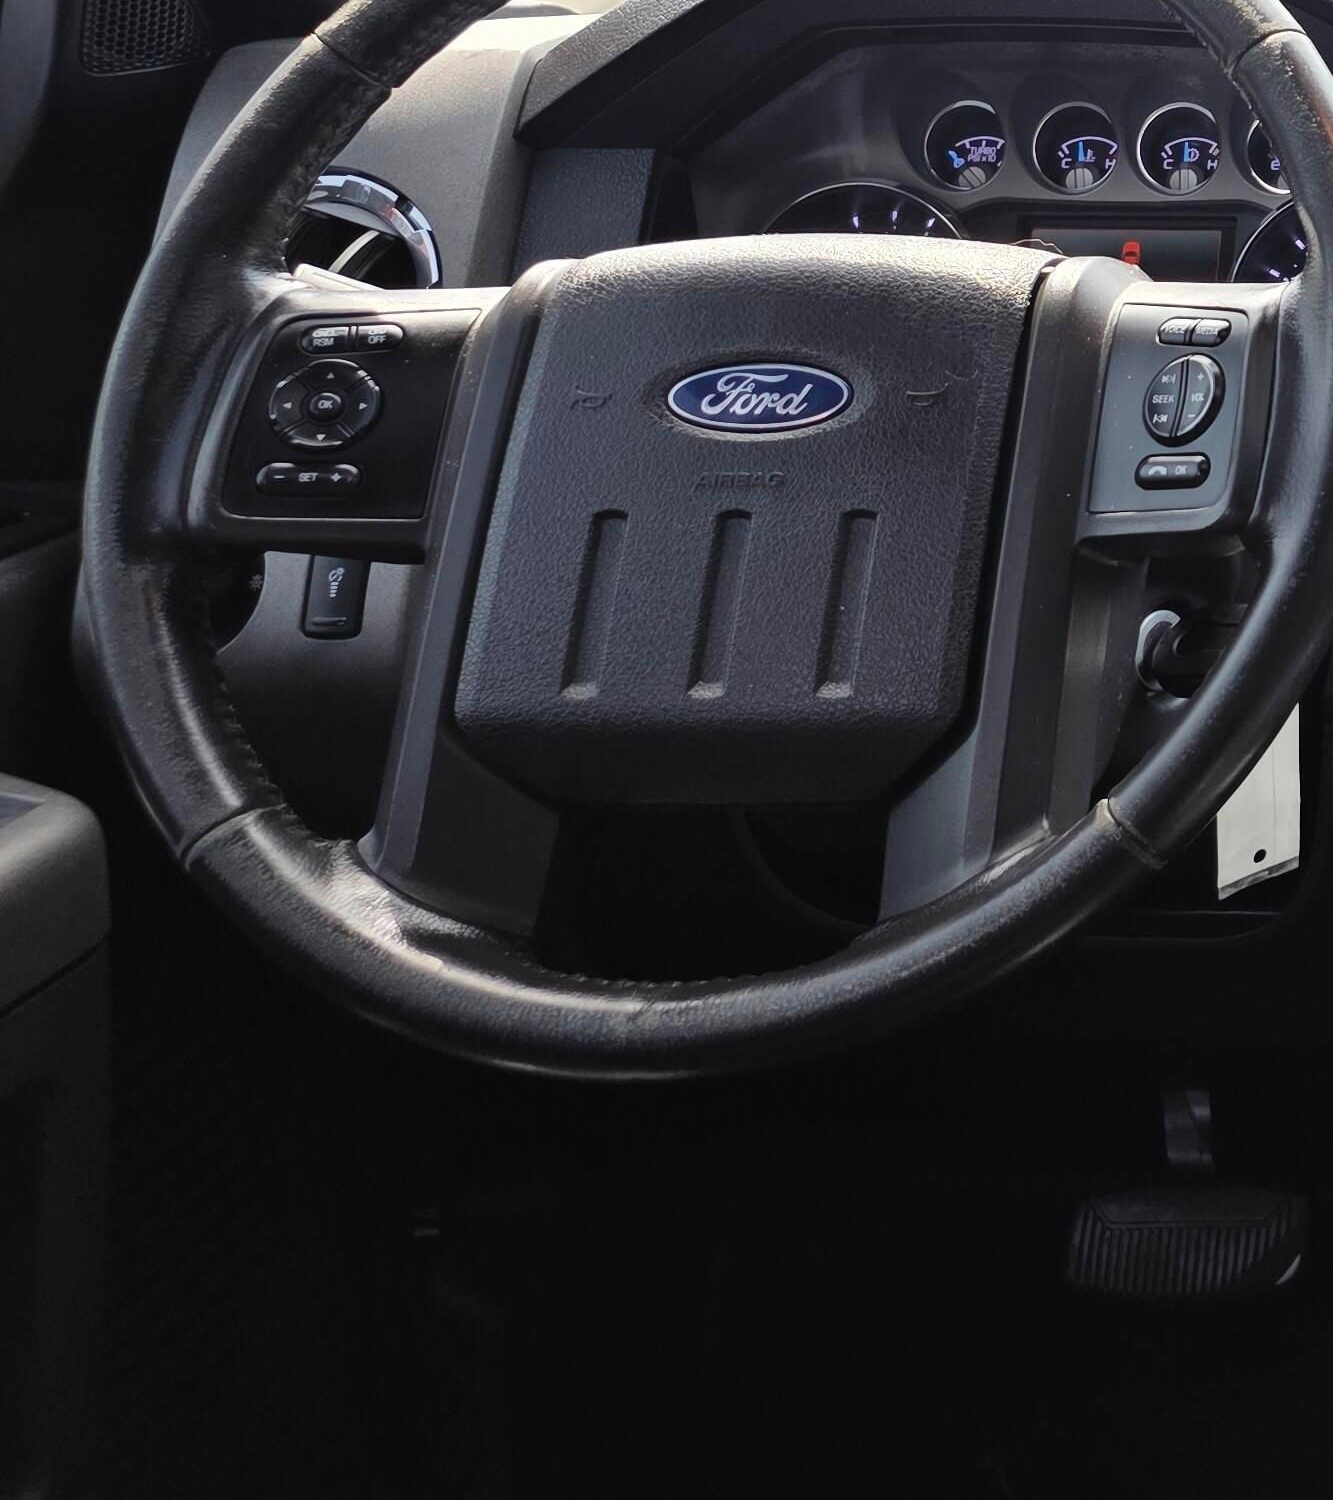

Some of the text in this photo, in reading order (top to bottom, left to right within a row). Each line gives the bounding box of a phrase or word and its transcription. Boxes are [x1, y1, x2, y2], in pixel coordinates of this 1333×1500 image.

[970, 146, 997, 155] TURBO
[1060, 158, 1073, 169] C
[1104, 158, 1117, 169] H
[1163, 159, 1175, 170] C
[1207, 159, 1218, 170] H
[312, 338, 335, 347] RSM
[367, 335, 387, 345] OFF
[700, 372, 814, 416] Ford
[1152, 394, 1175, 404] SEEK
[1191, 392, 1205, 402] VOL
[317, 399, 334, 410] OK
[1175, 465, 1188, 475] OK
[298, 472, 319, 483] SET
